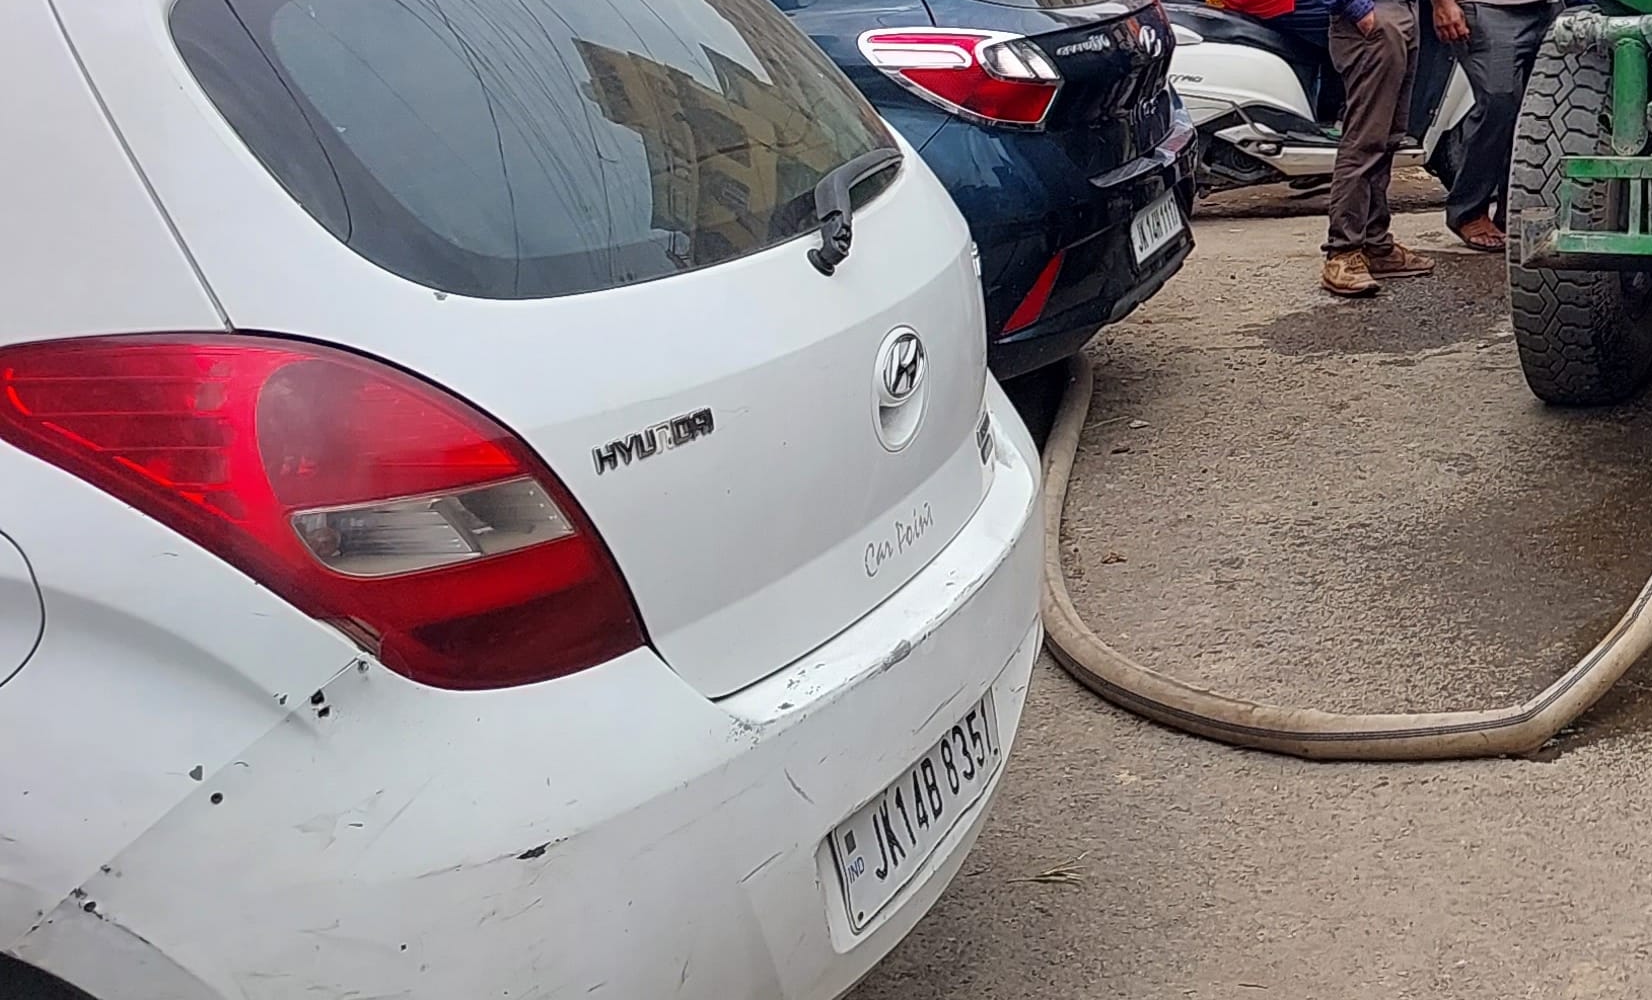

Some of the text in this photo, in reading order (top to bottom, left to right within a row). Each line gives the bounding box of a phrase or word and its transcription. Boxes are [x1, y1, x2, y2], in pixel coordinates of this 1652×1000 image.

[863, 502, 934, 578] Car Point
[847, 856, 865, 883] IND
